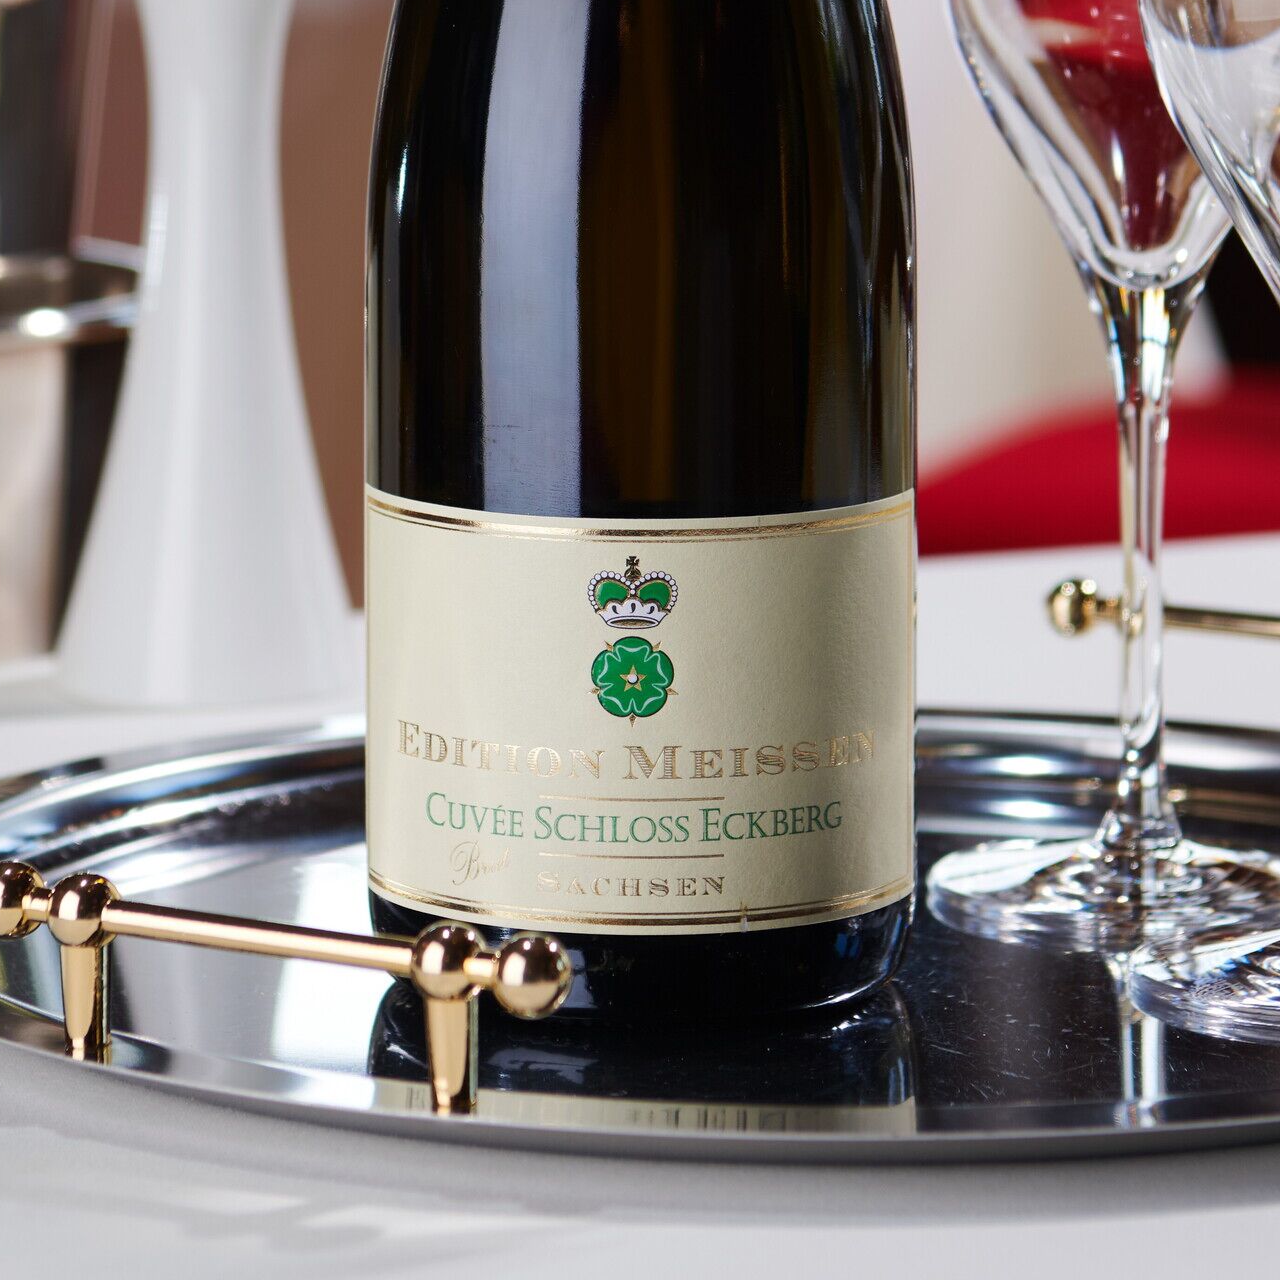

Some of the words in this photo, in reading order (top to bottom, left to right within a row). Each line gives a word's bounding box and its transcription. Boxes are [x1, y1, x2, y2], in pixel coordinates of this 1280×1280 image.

[397, 719, 606, 780] EDITION
[622, 728, 876, 780] MEISSEN
[426, 791, 524, 838] CUVÉE
[534, 805, 690, 843] SCHLOSS
[699, 800, 843, 842] ECKBERG
[536, 871, 726, 898] SACHSEN
